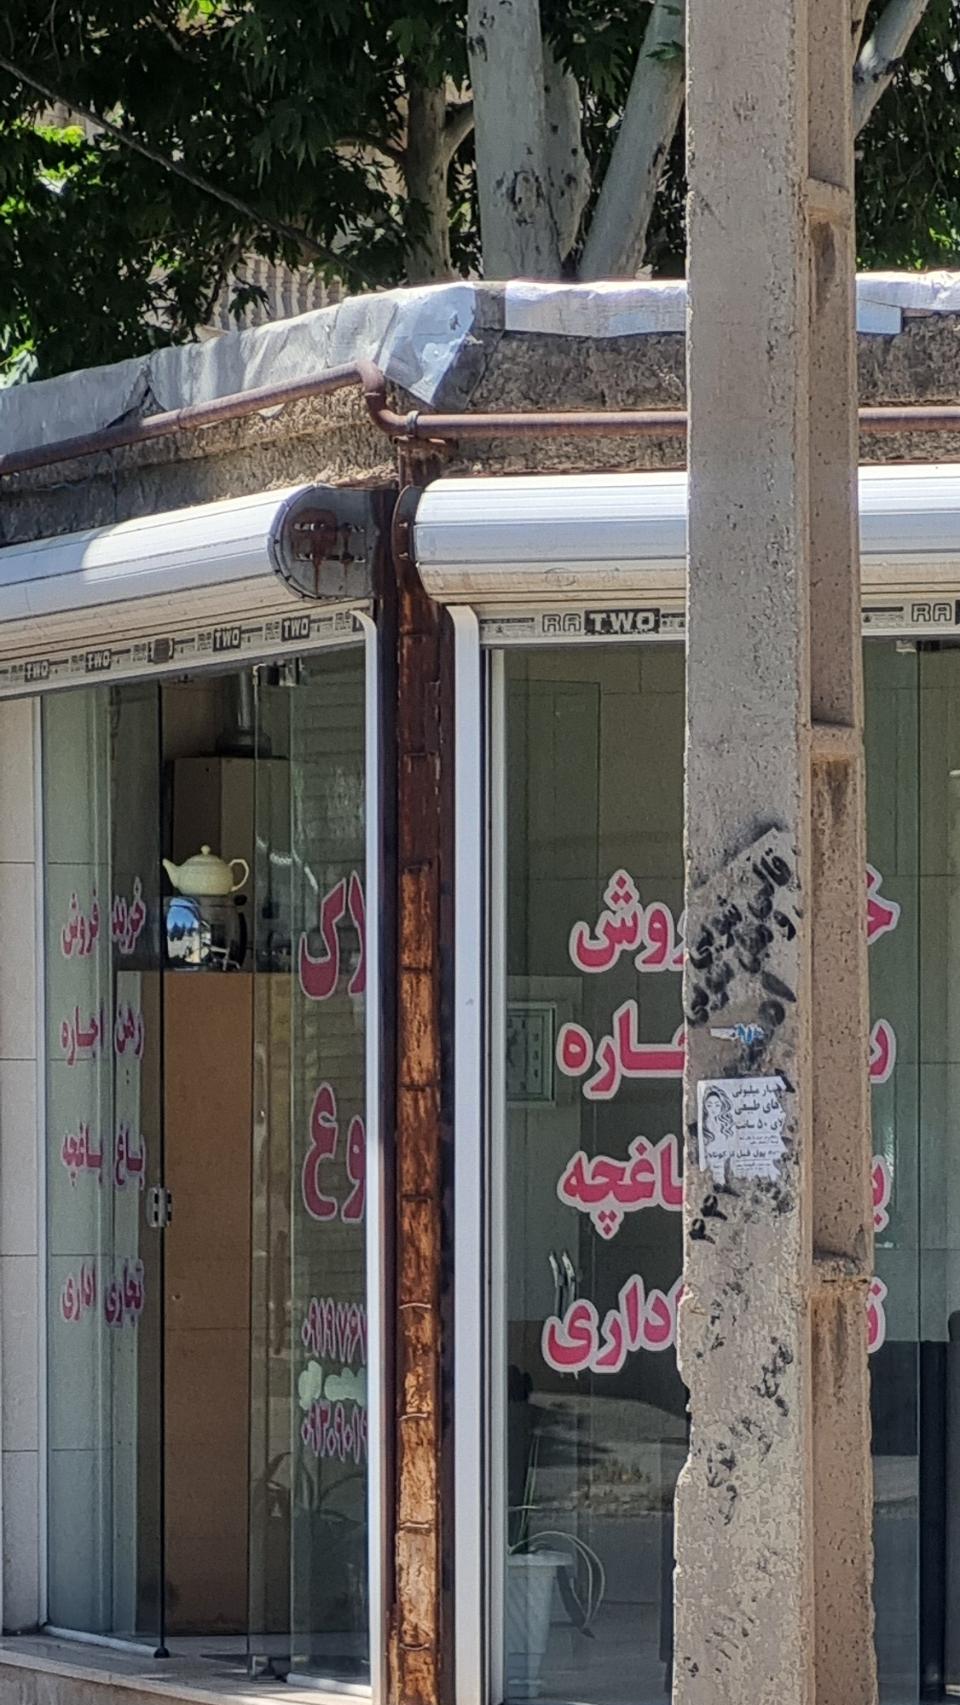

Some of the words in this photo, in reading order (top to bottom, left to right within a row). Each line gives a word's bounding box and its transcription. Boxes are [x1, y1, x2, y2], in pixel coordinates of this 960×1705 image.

[588, 610, 656, 633] TWO
[558, 1136, 685, 1239] اغچه
[543, 1275, 683, 1372] داری
